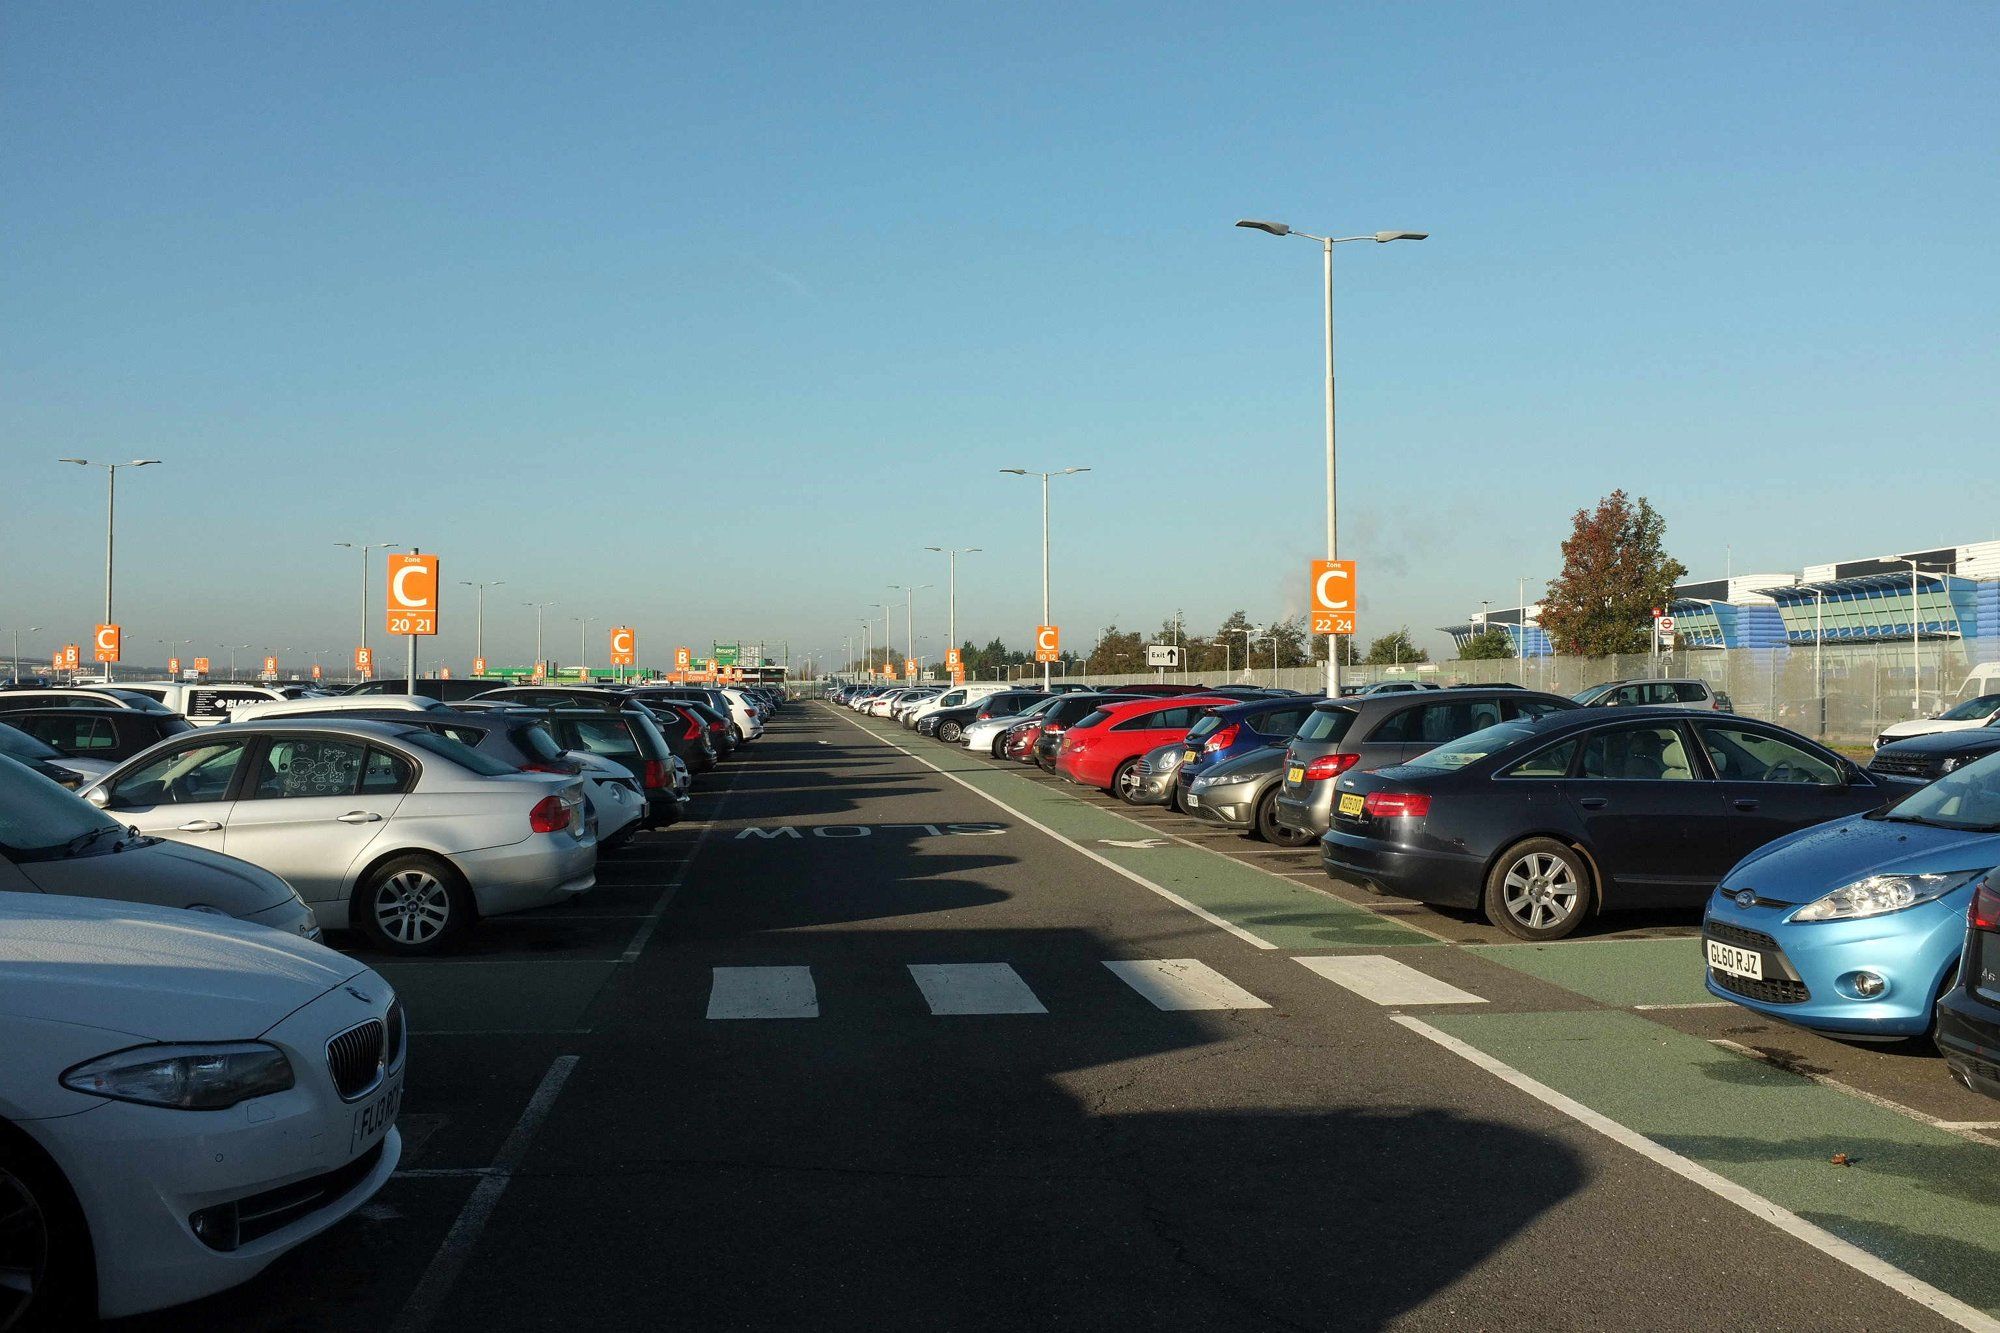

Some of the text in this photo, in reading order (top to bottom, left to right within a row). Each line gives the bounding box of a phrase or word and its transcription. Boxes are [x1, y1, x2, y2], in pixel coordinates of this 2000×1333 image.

[393, 565, 428, 607] C
[1316, 570, 1348, 609] C
[391, 619, 430, 632] 20 21
[1315, 620, 1352, 631] 22 24
[98, 629, 115, 649] C
[613, 633, 630, 652] C
[1039, 630, 1054, 649] C
[55, 655, 62, 664] B
[66, 649, 76, 662] B
[359, 651, 368, 663] B
[678, 651, 687, 664] B
[949, 652, 957, 664] B
[171, 660, 177, 668] B
[267, 659, 274, 669] B
[476, 660, 483, 669] B
[709, 663, 715, 671] B
[908, 661, 914, 670] B
[734, 822, 1008, 839] SLOW
[1711, 944, 1758, 975] GL60 RJZ
